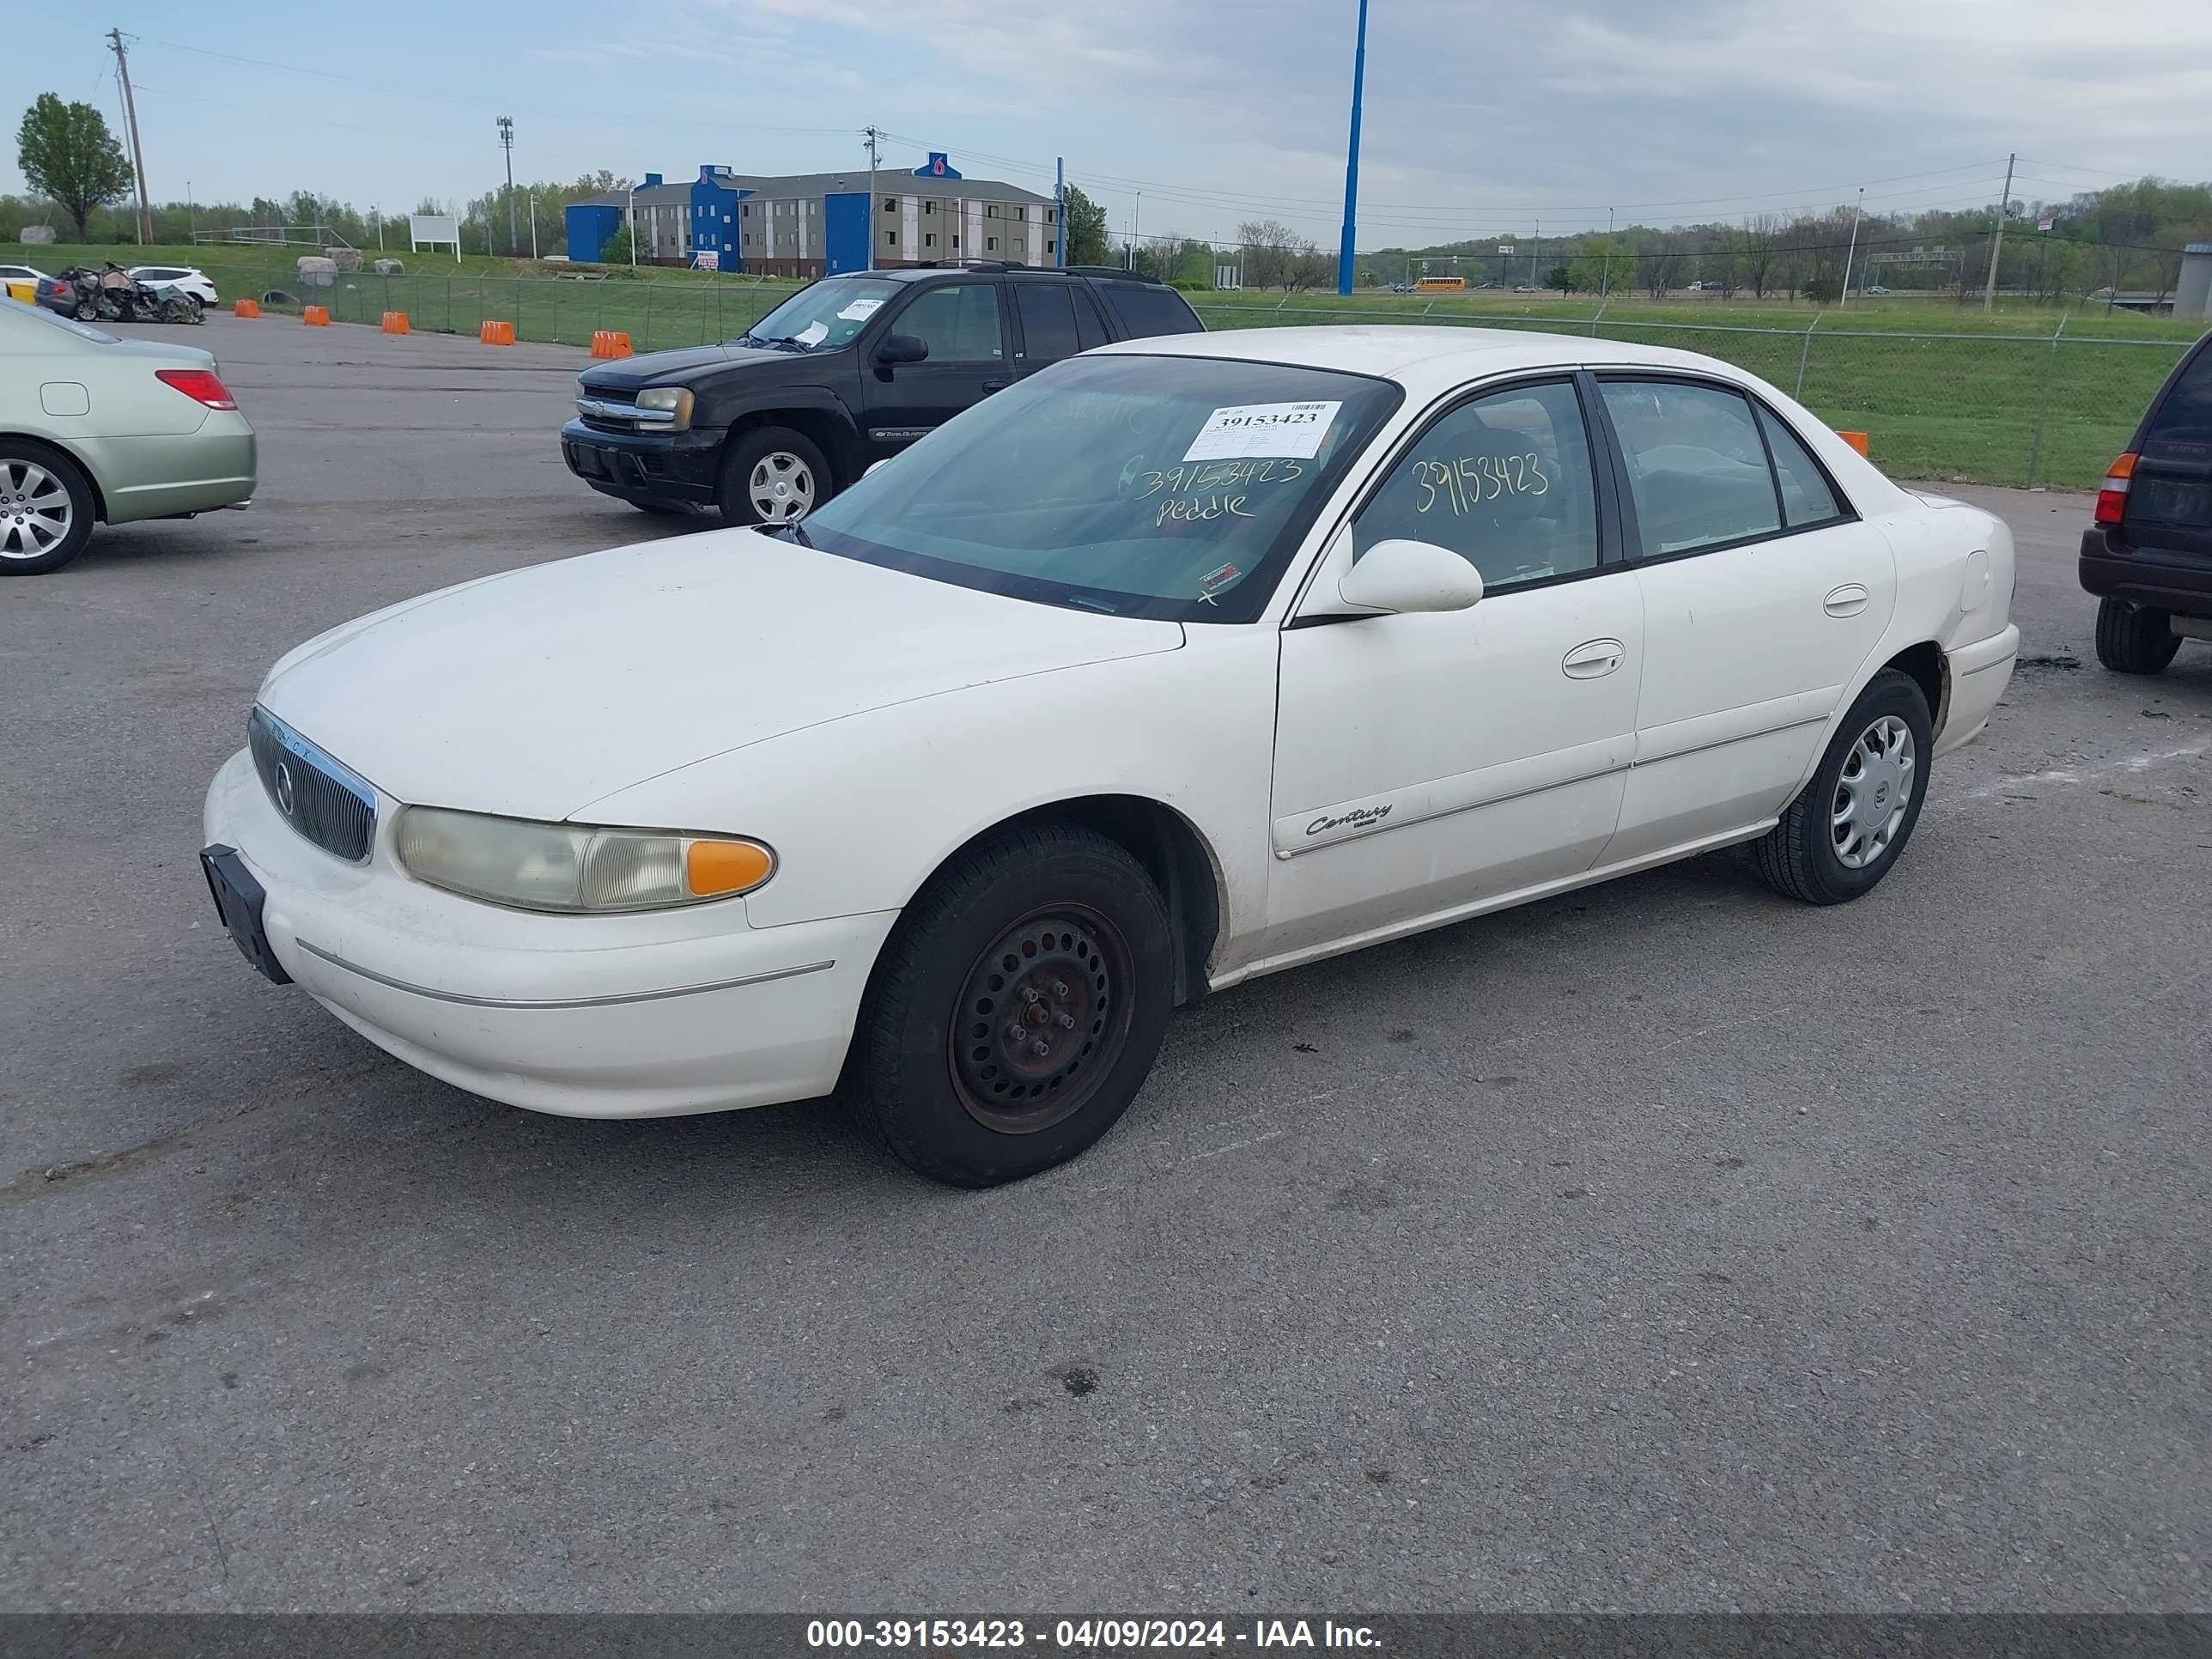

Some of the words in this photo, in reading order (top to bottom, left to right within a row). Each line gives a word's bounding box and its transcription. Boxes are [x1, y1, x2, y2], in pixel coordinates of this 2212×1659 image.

[934, 157, 945, 175] 6
[1215, 413, 1318, 428] 39153423
[1133, 459, 1303, 501] 39153423
[1412, 453, 1548, 516] 39153423
[1305, 804, 1393, 836] Century
